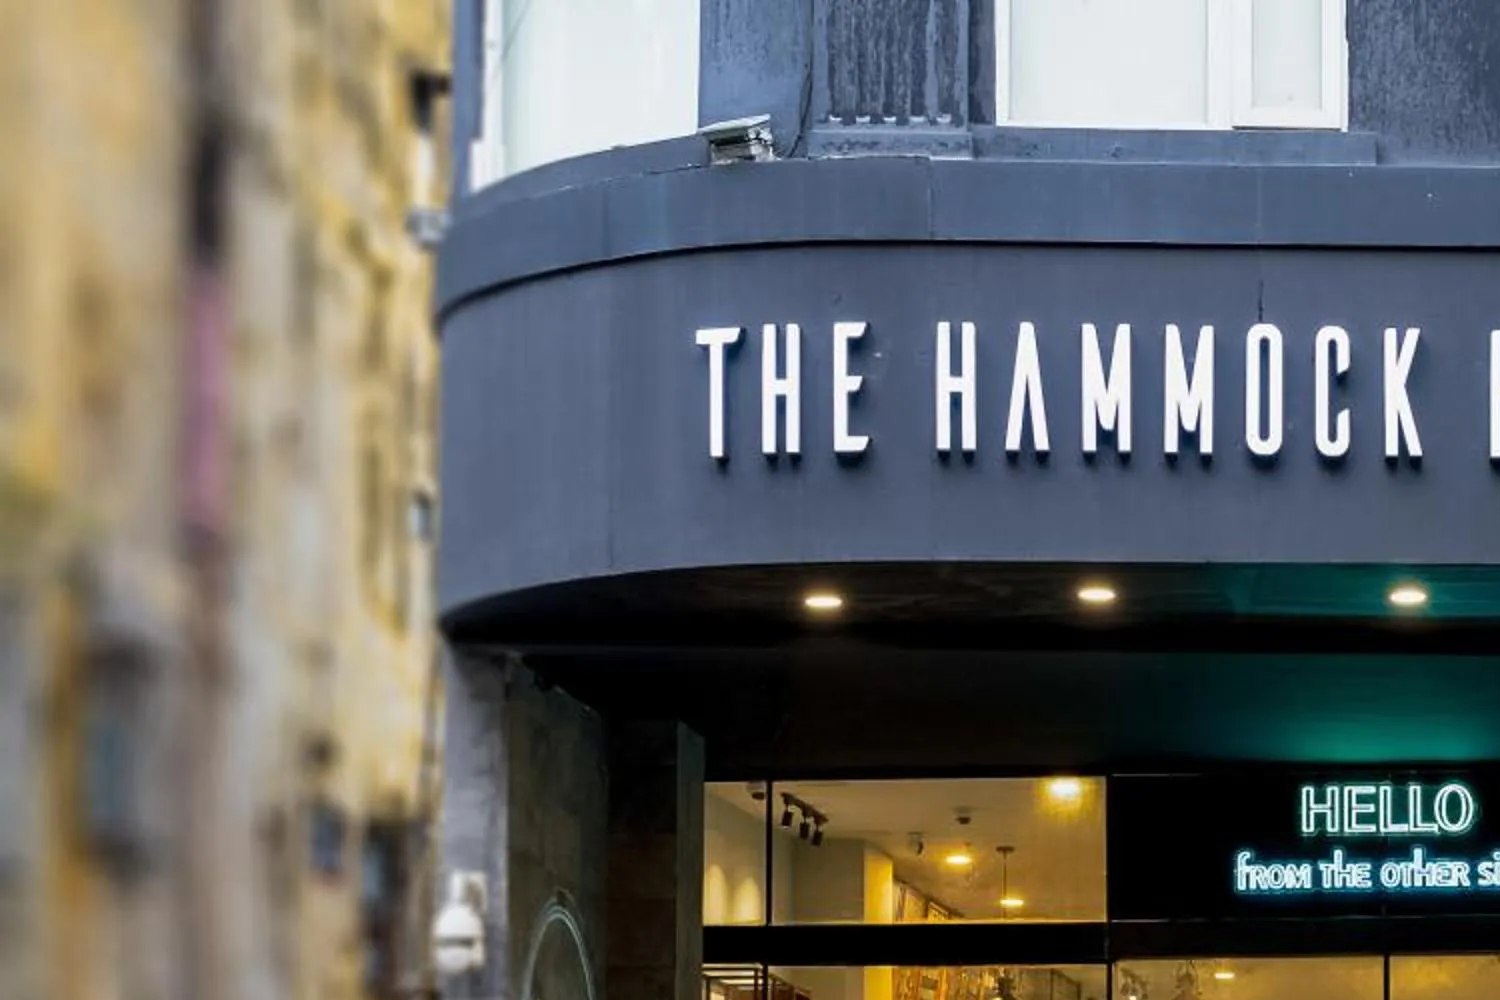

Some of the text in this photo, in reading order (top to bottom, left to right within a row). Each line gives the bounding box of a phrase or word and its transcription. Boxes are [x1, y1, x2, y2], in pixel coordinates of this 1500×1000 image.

[695, 320, 871, 461] THE
[936, 320, 1423, 460] HAMMOCK
[1301, 783, 1475, 834] HELLO
